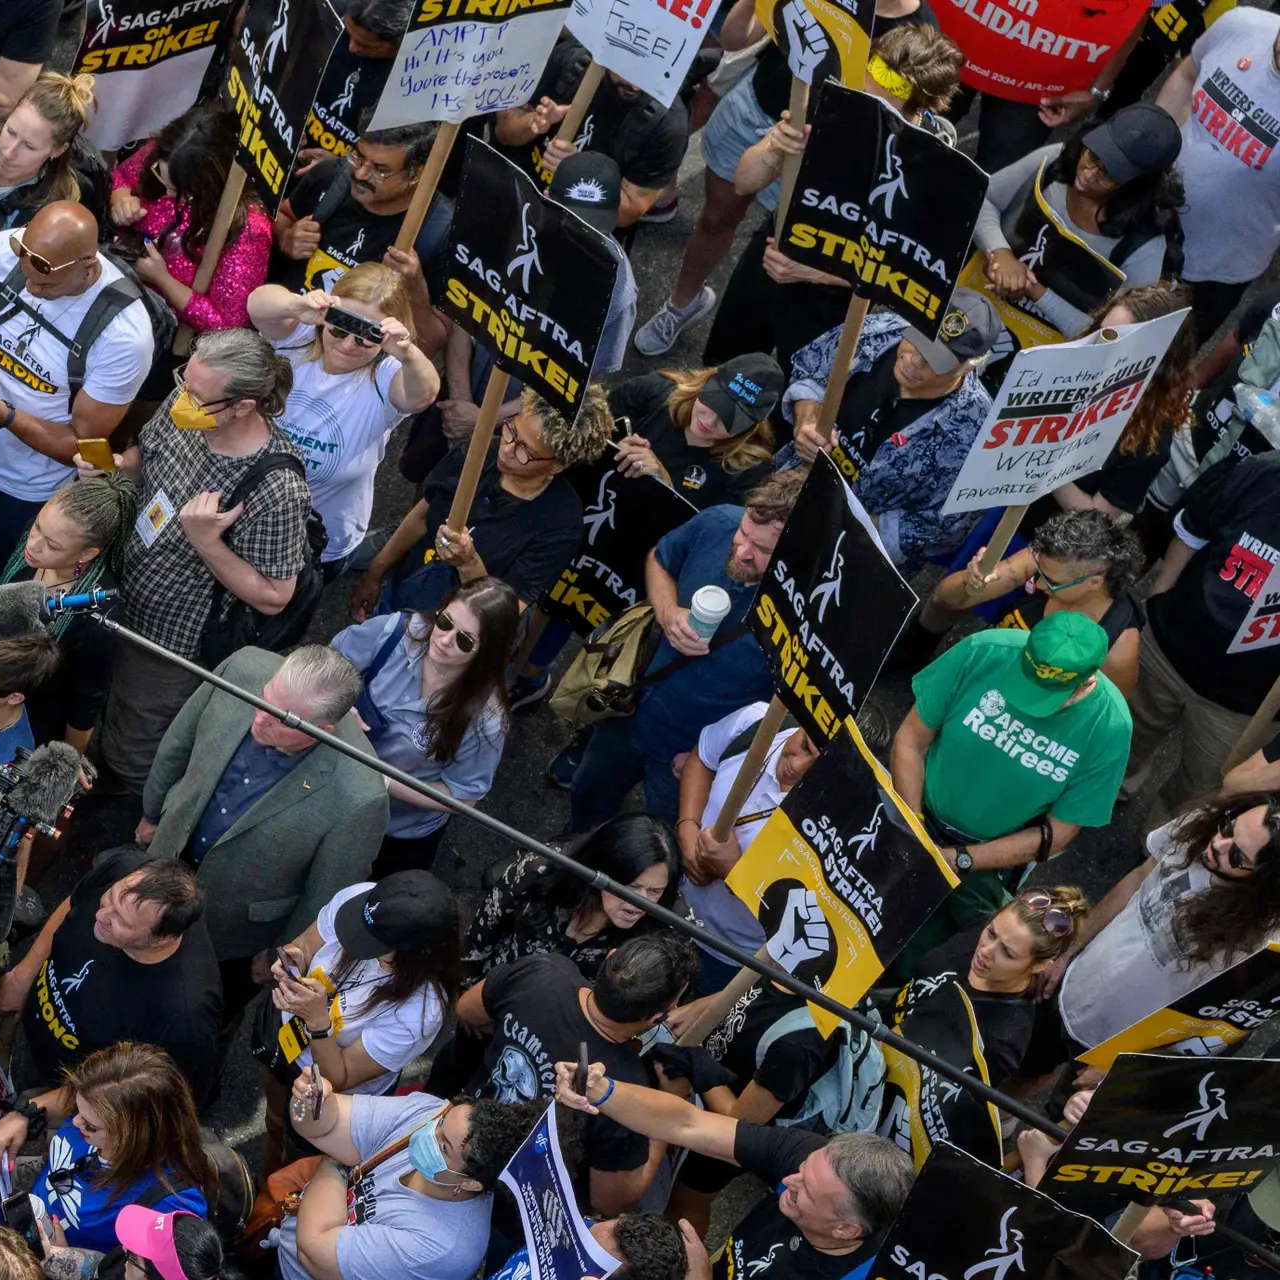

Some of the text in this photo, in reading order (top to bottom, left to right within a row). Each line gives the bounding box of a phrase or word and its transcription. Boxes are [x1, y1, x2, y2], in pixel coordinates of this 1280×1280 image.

[80, 20, 220, 74] STRIKE!
[144, 24, 172, 42] ON
[414, 21, 509, 52] AMPTP
[450, 68, 478, 86] the
[472, 47, 504, 70] you
[965, 60, 1065, 93] Local 2334 AFL-CIO
[1210, 65, 1256, 116] WRITERS
[226, 65, 285, 197] STRIKE!
[1190, 90, 1272, 173] STRIKE!
[1231, 107, 1246, 122] ON
[861, 234, 886, 261] ON
[787, 222, 943, 321] STRIKE!
[445, 278, 580, 405] STRIKE!
[499, 310, 526, 341] ON
[1006, 354, 1158, 407] WRITERS GUILD
[1053, 370, 1106, 386] rather
[982, 382, 1142, 450] STRIKE!
[997, 431, 1102, 471] WRITING
[956, 455, 1095, 502] FAVORITE SHOW!
[756, 593, 844, 741] STRIKE!
[791, 634, 809, 669] ON
[961, 706, 1069, 784] Retirees
[994, 712, 1080, 769] AFSCME
[801, 817, 884, 938] ON STRIKE!
[1198, 1005, 1224, 1019] ON
[1052, 1163, 1259, 1195] STRIKE!
[1147, 1162, 1189, 1175] ON
